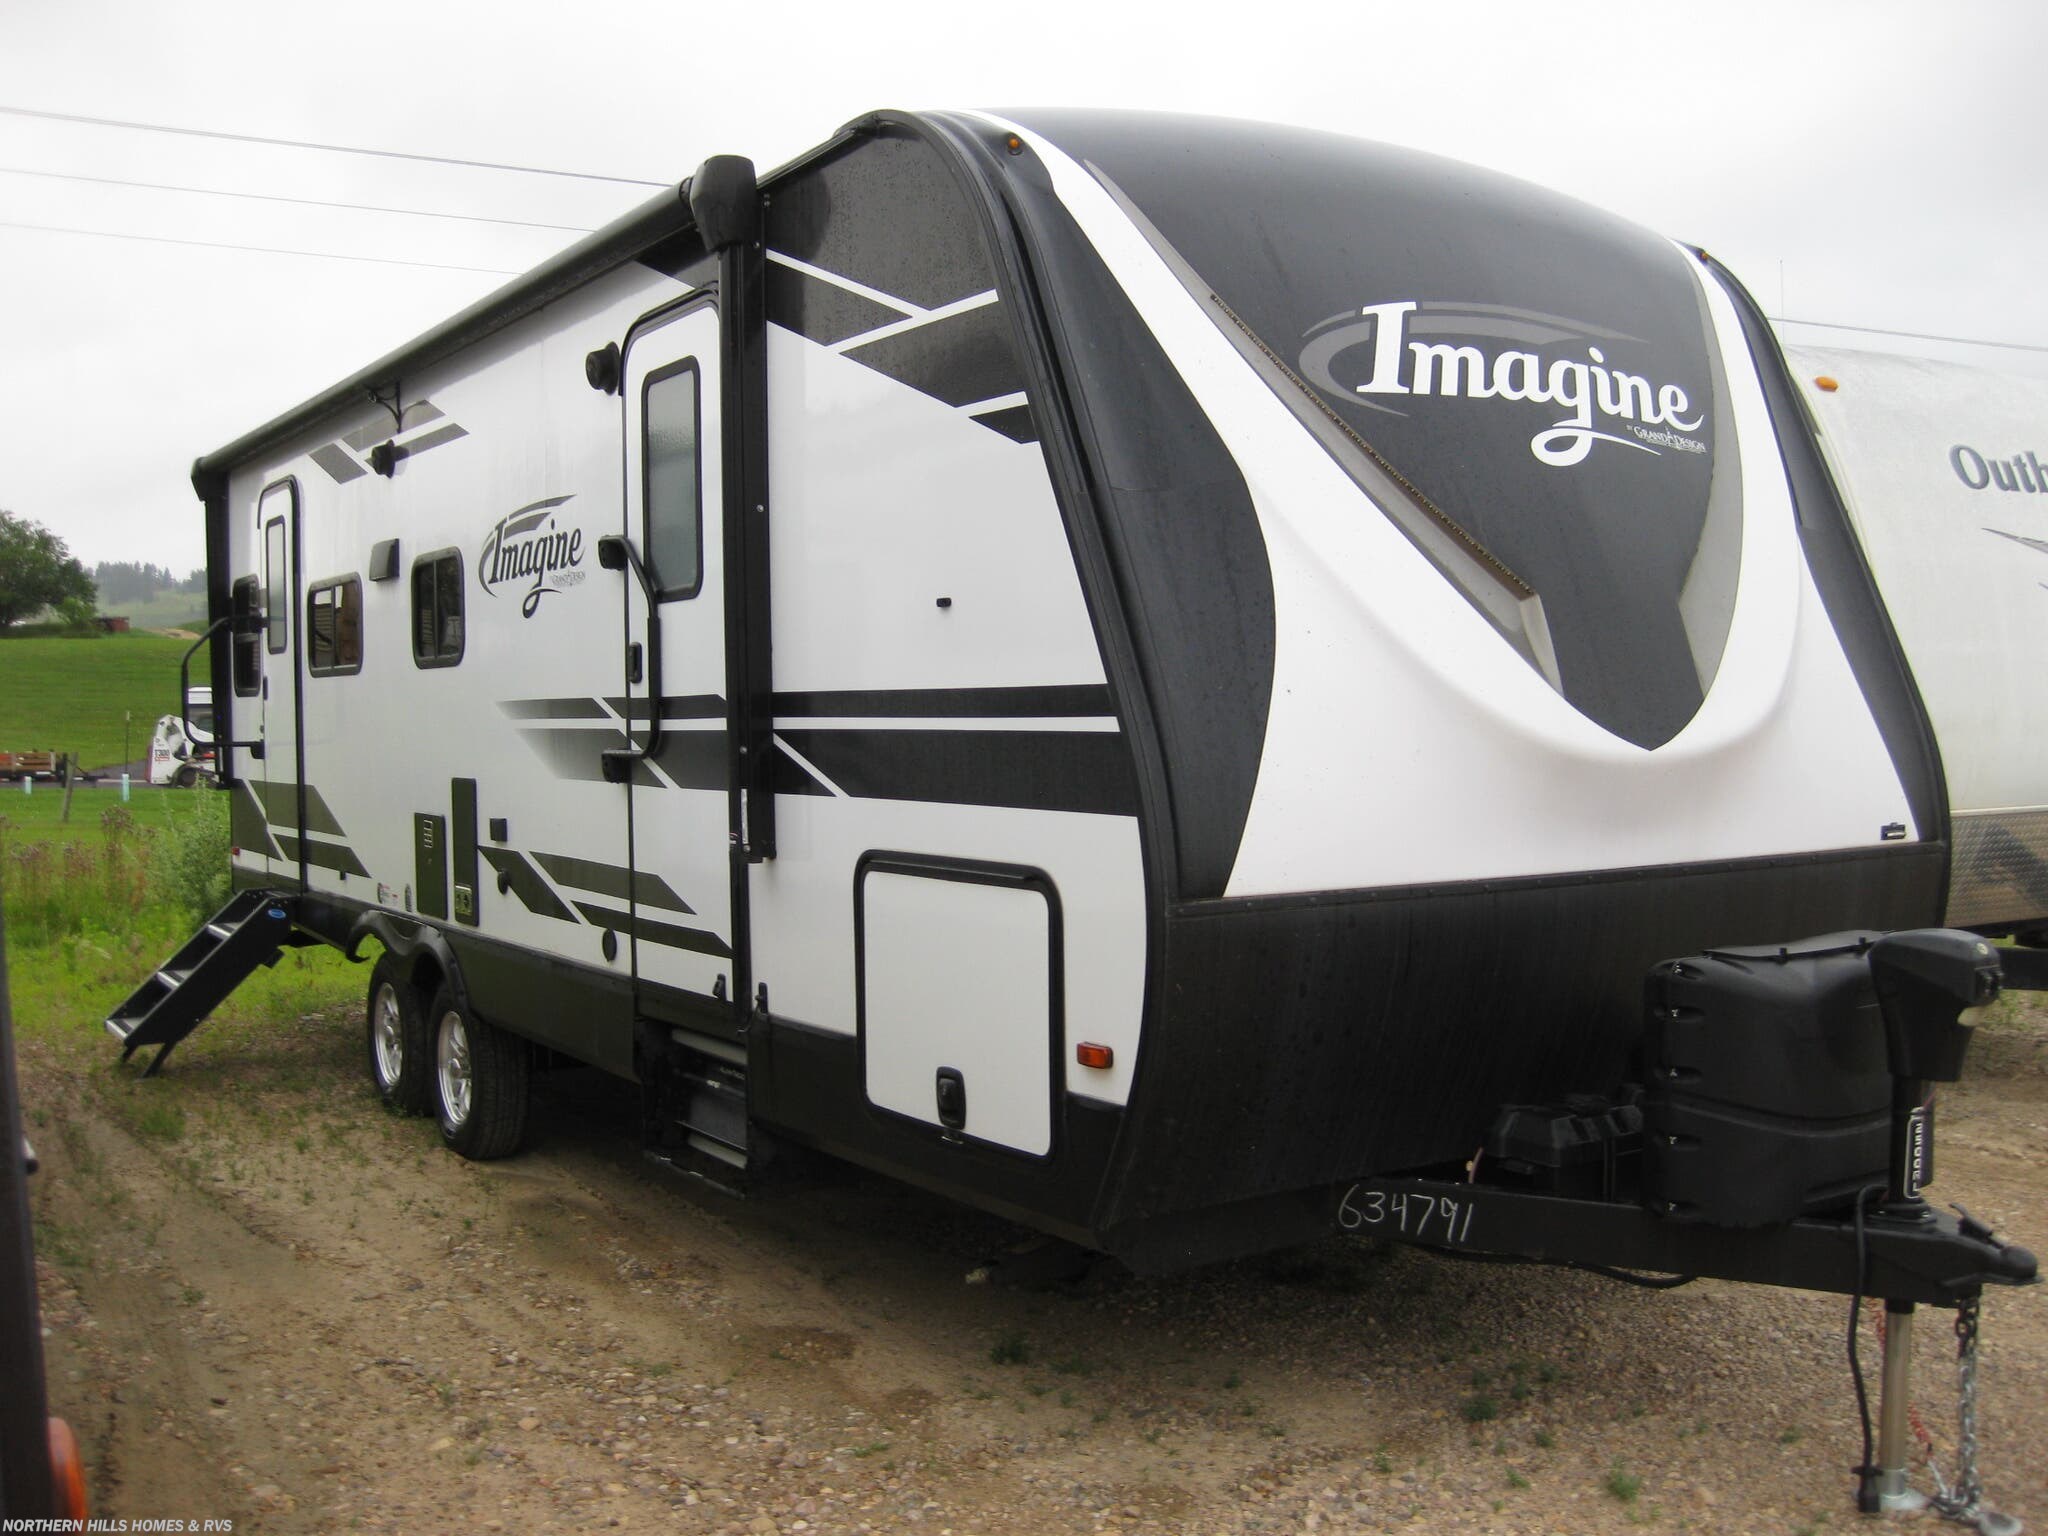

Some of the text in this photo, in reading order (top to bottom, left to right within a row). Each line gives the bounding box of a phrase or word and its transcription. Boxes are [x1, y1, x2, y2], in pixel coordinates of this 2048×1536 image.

[1356, 301, 1704, 467] Imagine
[488, 517, 585, 619] Imagine
[1338, 1184, 1473, 1242] 634791
